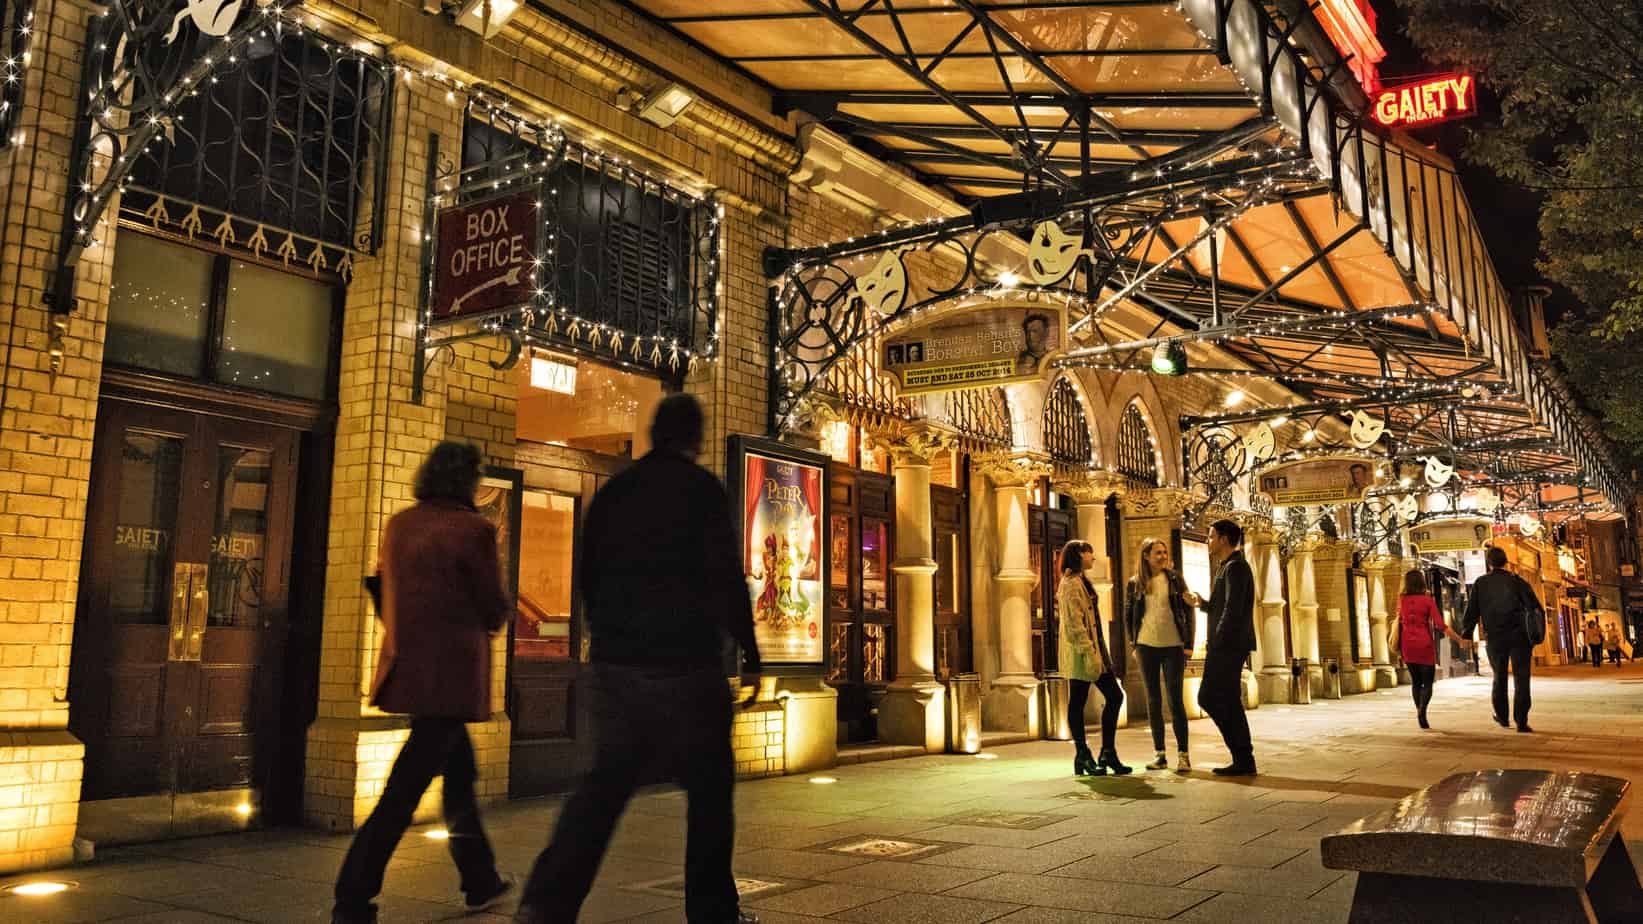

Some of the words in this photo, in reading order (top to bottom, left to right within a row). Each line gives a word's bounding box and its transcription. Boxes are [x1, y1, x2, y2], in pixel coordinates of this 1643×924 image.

[1376, 76, 1470, 124] GAIETY
[466, 204, 509, 241] BOX
[450, 234, 523, 277] OFFICE
[906, 375, 930, 385] MUST
[931, 374, 947, 383] END
[949, 372, 963, 381] SAT
[765, 478, 805, 507] PETER
